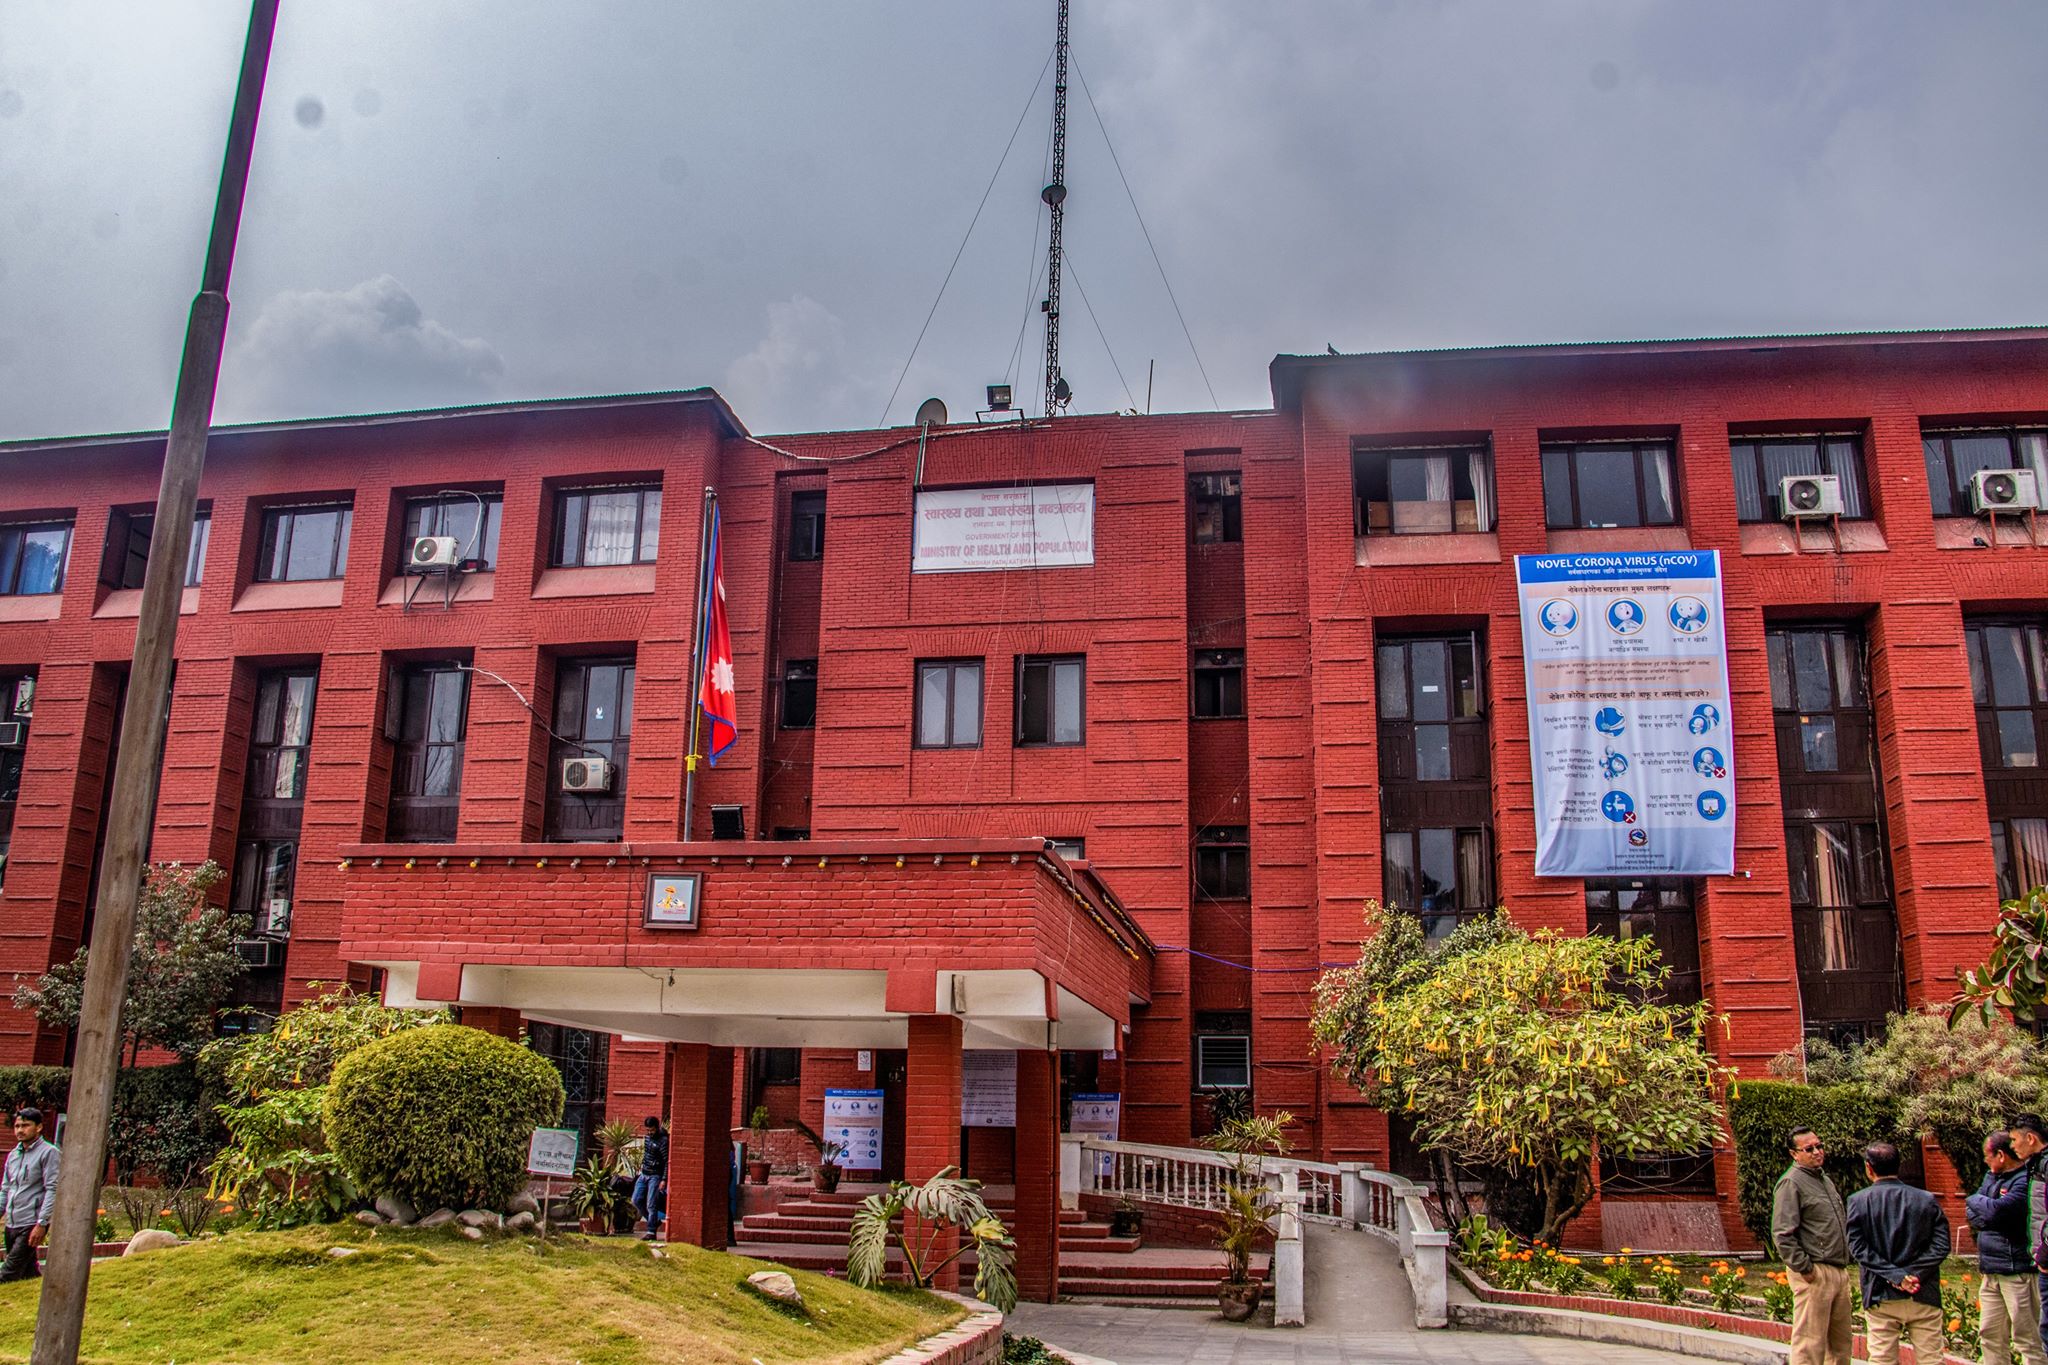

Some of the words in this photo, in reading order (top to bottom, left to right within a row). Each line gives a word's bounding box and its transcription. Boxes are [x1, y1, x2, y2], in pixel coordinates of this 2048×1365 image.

[924, 508, 961, 520] स्वास्थ्य
[964, 507, 984, 518] तथा
[965, 532, 1009, 541] GOVERNMENT
[920, 545, 962, 558] MINISTRY
[963, 544, 975, 557] OF
[977, 543, 1011, 556] HEALTH
[1012, 542, 1031, 555] AND
[1034, 540, 1089, 554] POPULATION
[1536, 558, 1573, 569] NOVEL
[1575, 556, 1623, 567] CORONA
[1624, 555, 1657, 566] VIRUS
[1659, 554, 1698, 567] (nCOV)
